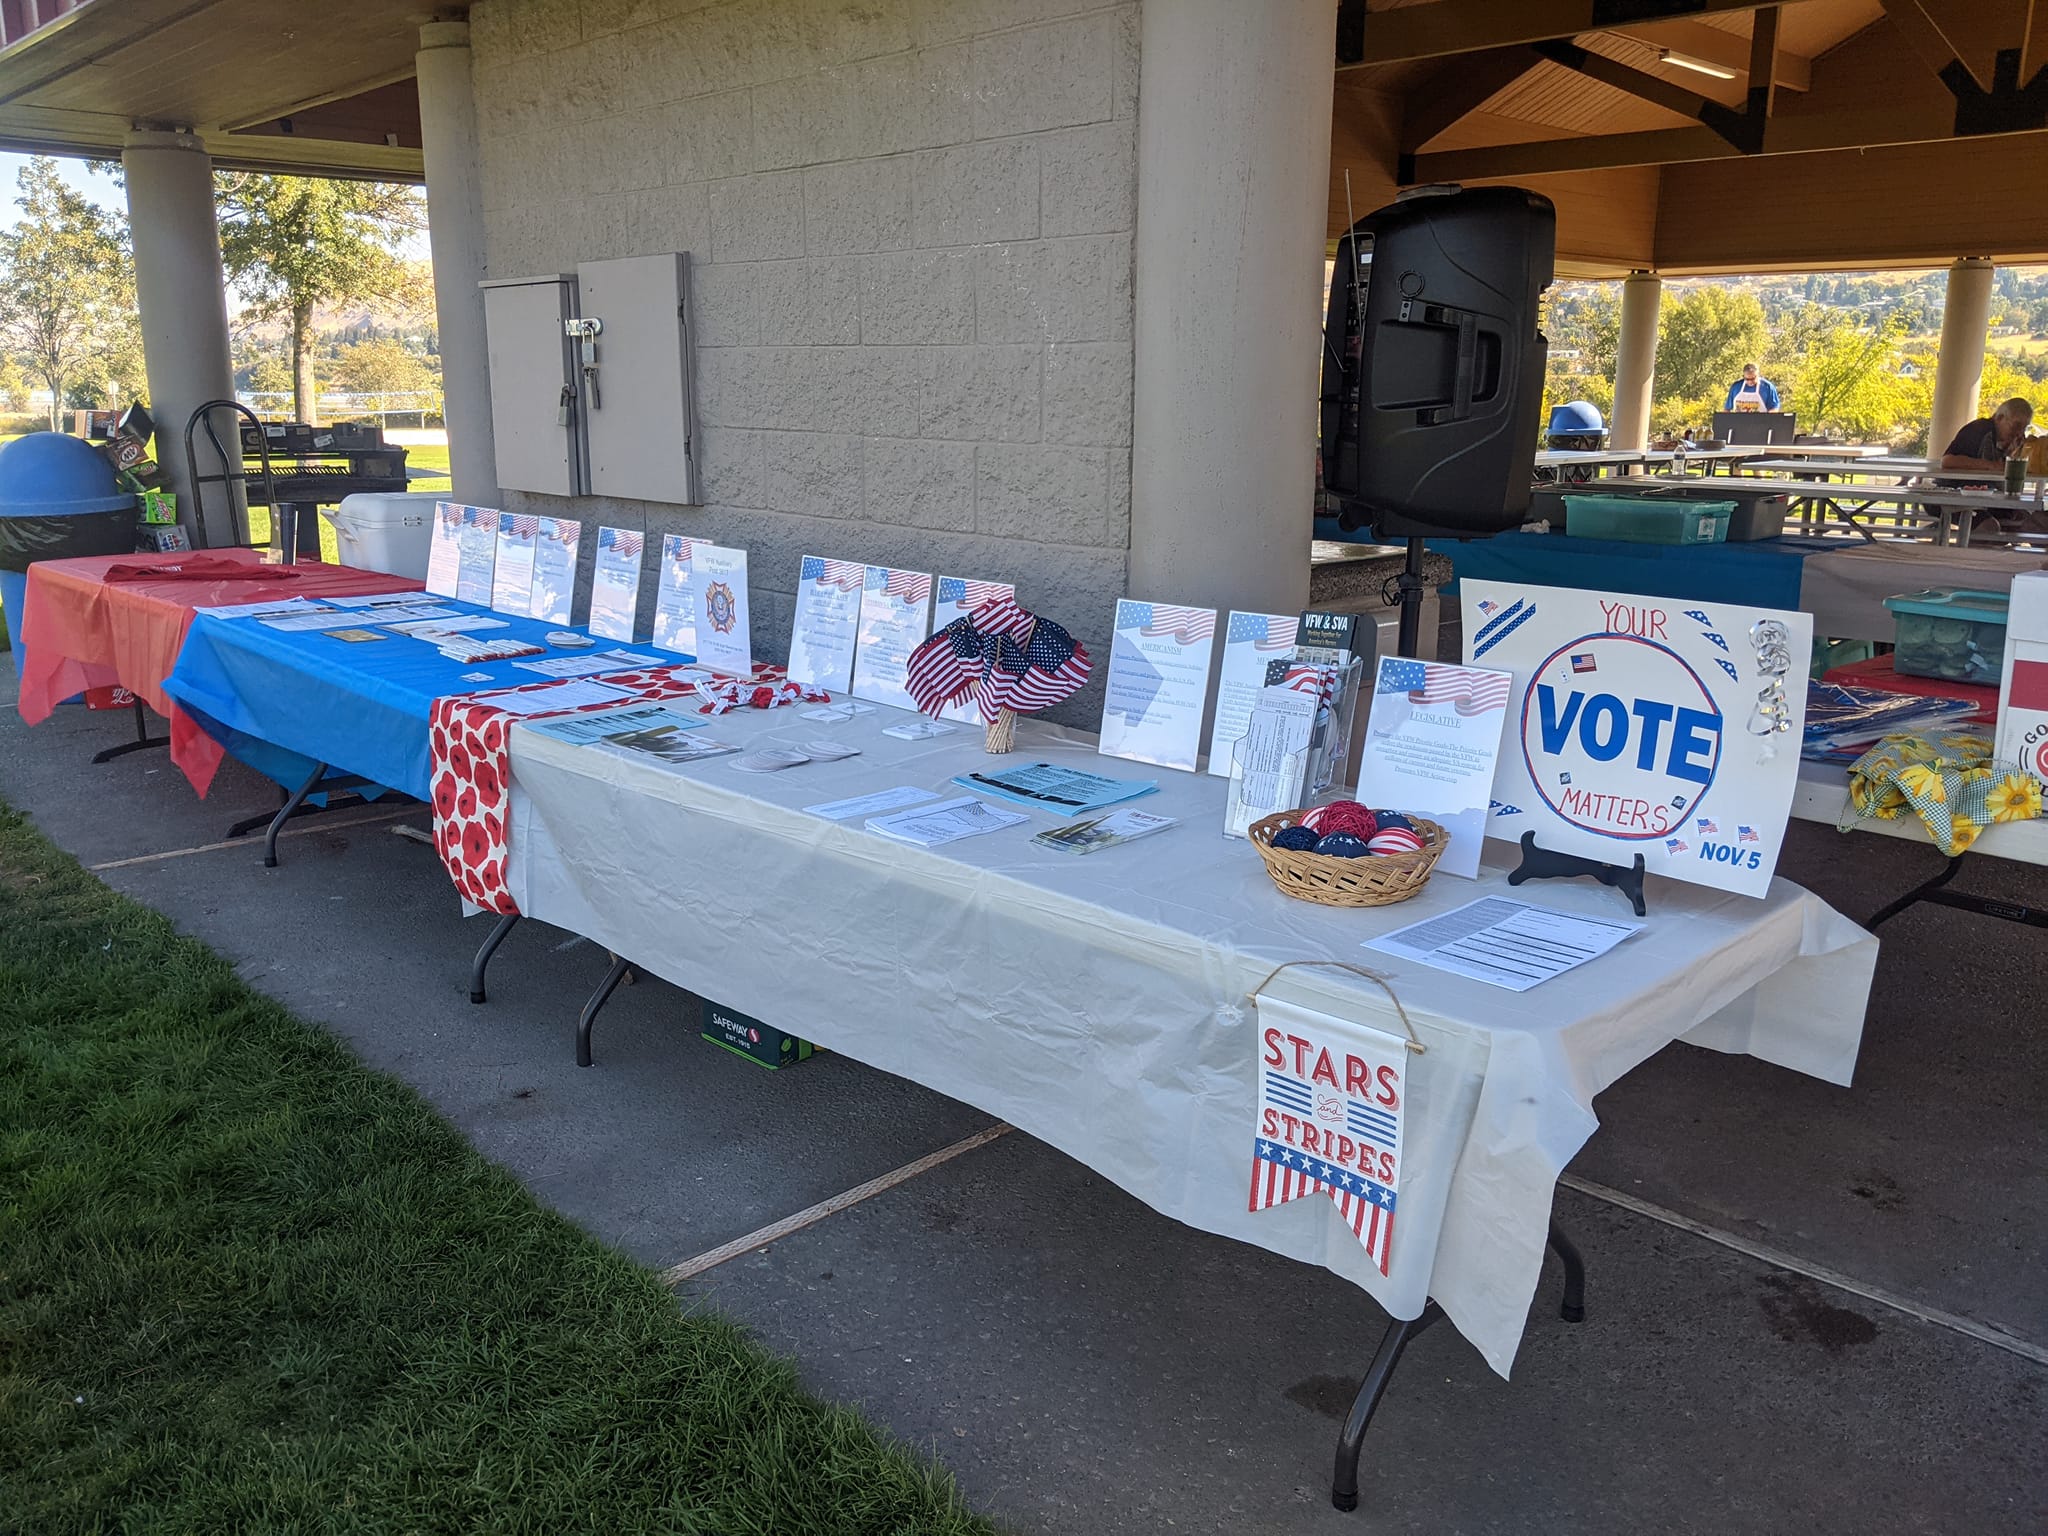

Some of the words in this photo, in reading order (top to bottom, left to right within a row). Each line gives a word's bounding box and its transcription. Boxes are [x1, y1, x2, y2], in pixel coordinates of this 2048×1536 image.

[1305, 613, 1324, 628] VFW
[1323, 615, 1331, 629] &
[1331, 616, 1348, 631] SVA
[1600, 600, 1668, 640] YOUR
[1141, 643, 1182, 656] AMERICANISM
[1409, 711, 1461, 728] LEGISLATIVE
[1537, 683, 1723, 785] VOTE
[2024, 724, 2048, 744] GO
[1557, 788, 1669, 833] MATTERS
[1699, 841, 1746, 866] NOV.
[1746, 851, 1762, 870] 5
[713, 1013, 748, 1037] SAFEWAY
[1264, 1027, 1400, 1112] STARS
[1317, 1103, 1344, 1117] and
[1262, 1107, 1396, 1186] STRIPES
